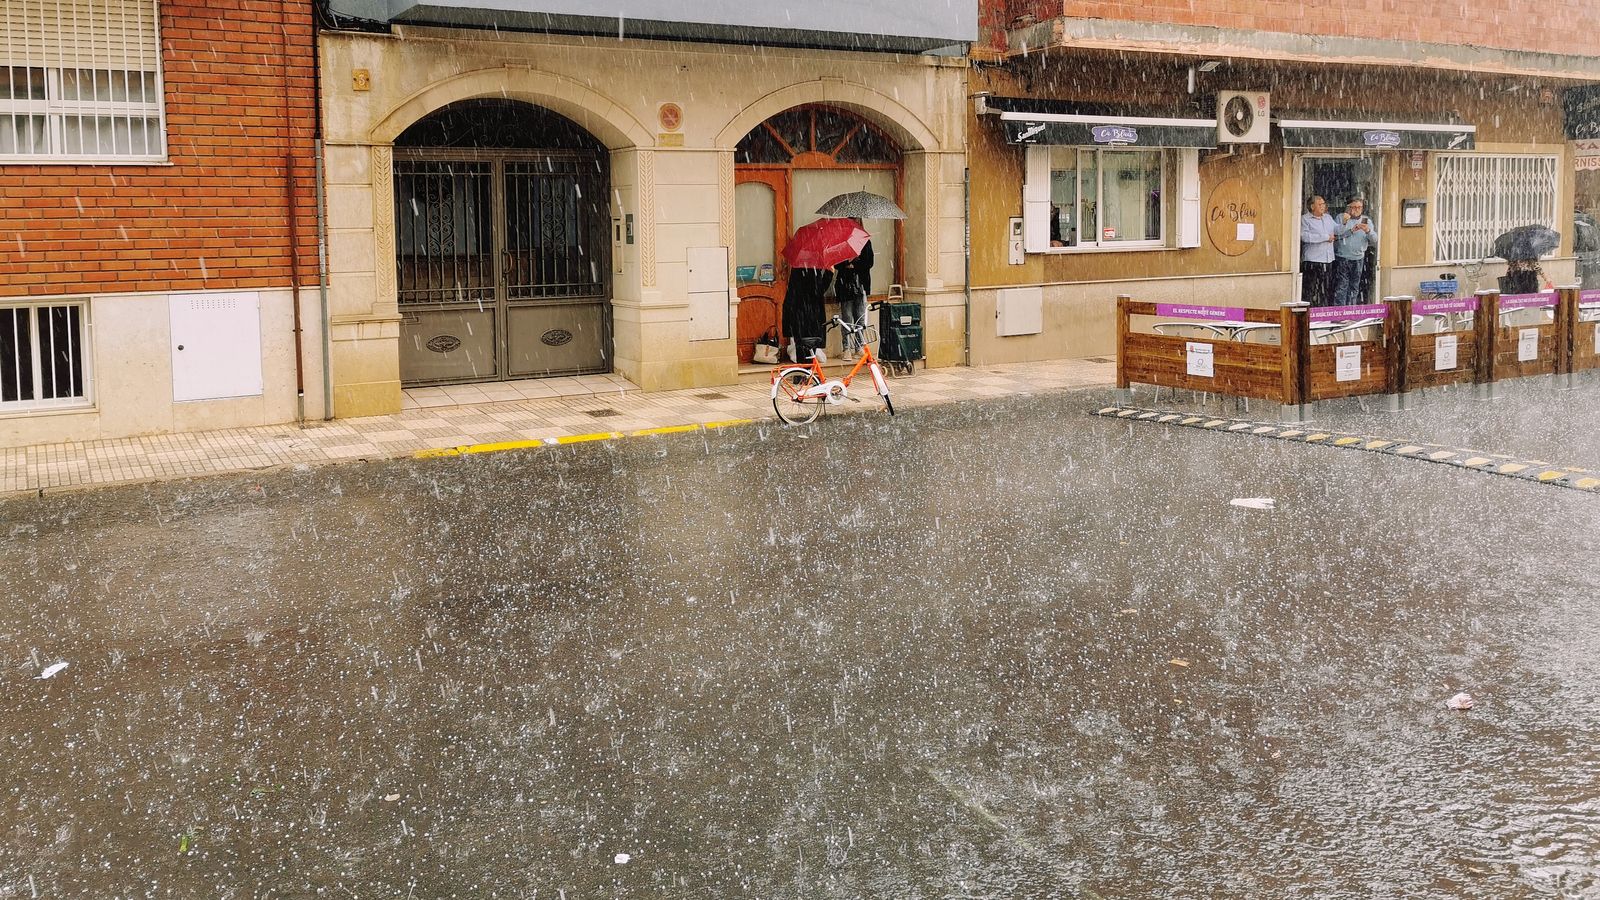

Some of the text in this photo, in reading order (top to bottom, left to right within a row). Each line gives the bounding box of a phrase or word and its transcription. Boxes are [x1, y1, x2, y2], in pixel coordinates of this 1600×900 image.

[1589, 121, 1600, 134] B
[1100, 129, 1134, 140] Ca Blau
[1211, 202, 1257, 222] Ca Blau
